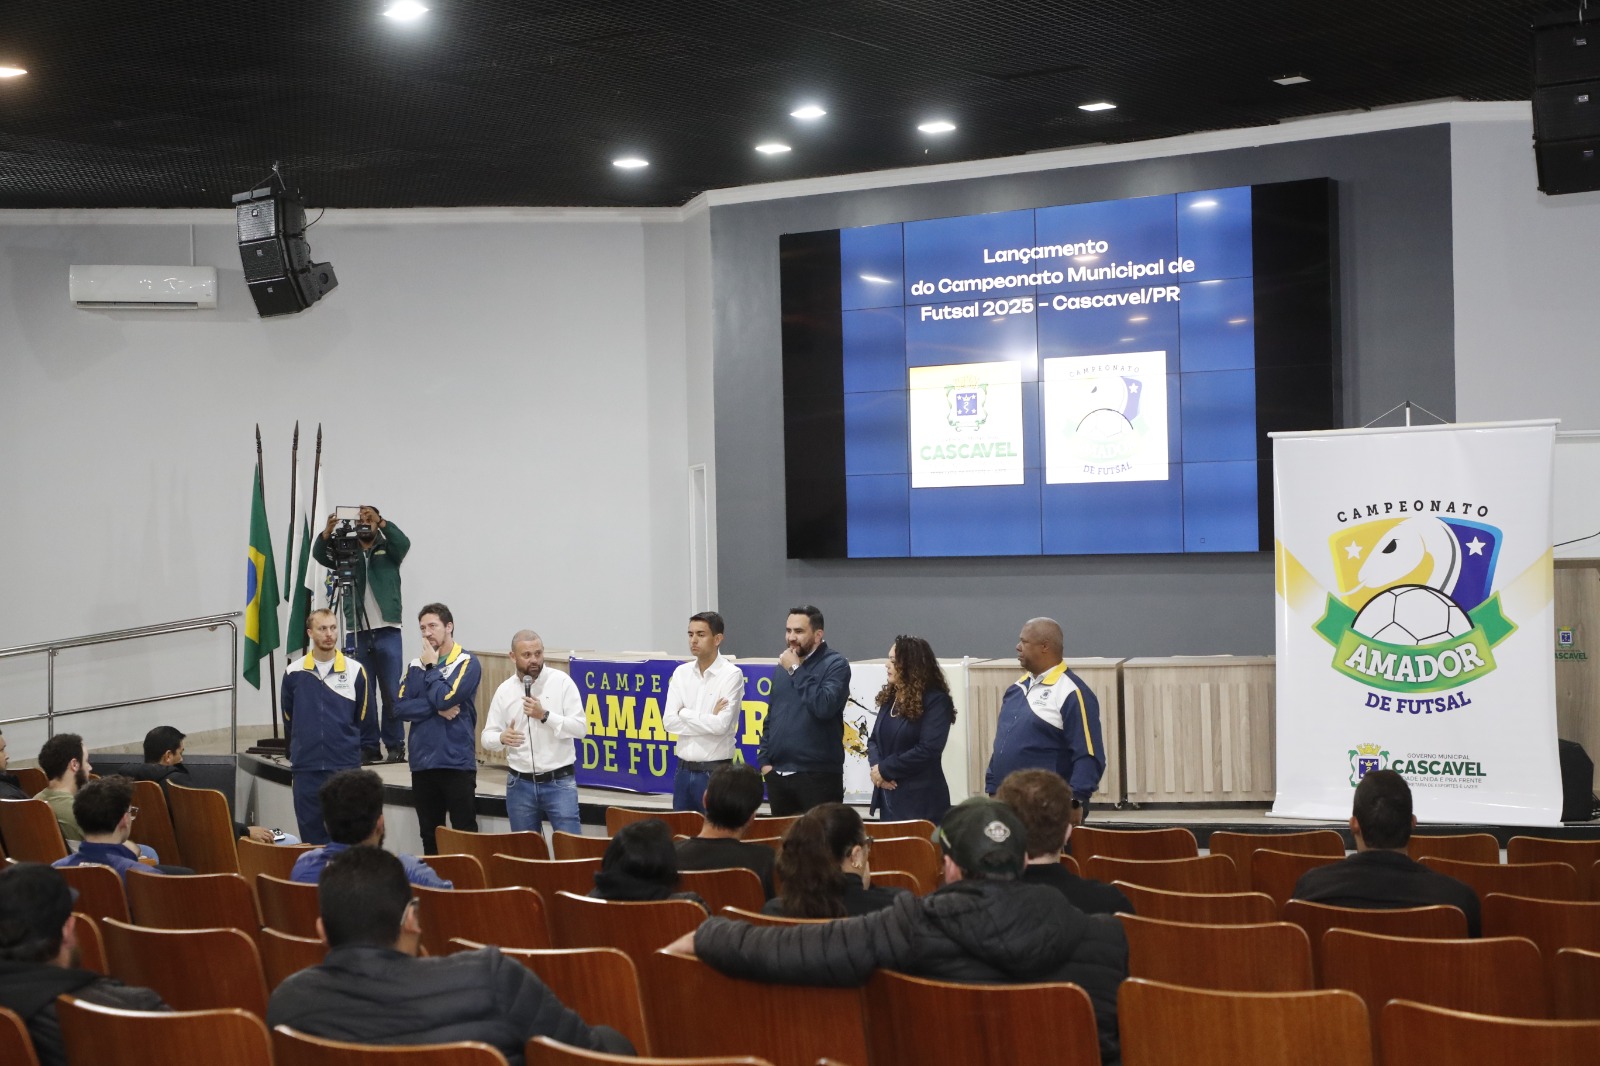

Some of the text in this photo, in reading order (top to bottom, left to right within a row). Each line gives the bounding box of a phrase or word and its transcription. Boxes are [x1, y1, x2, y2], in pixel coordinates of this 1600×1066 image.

[983, 239, 1109, 265] Lançamento
[911, 257, 1195, 296] do Campeonato Municipal de
[921, 302, 980, 322] Futsal
[982, 298, 1034, 317] 2025
[1052, 286, 1181, 311] Cascavel/PR
[1069, 365, 1140, 378] CAMPEONATO
[920, 442, 1018, 460] CASCAVEL
[1083, 462, 1133, 475] DE FUTSAL
[1336, 500, 1489, 523] CAMPEONATO
[1344, 641, 1486, 684] AMADOR
[1555, 652, 1588, 660] ASCAVEL
[1365, 691, 1472, 715] DE FUTSAL
[581, 738, 619, 772] DE
[1392, 760, 1487, 777] CASCAVEL
